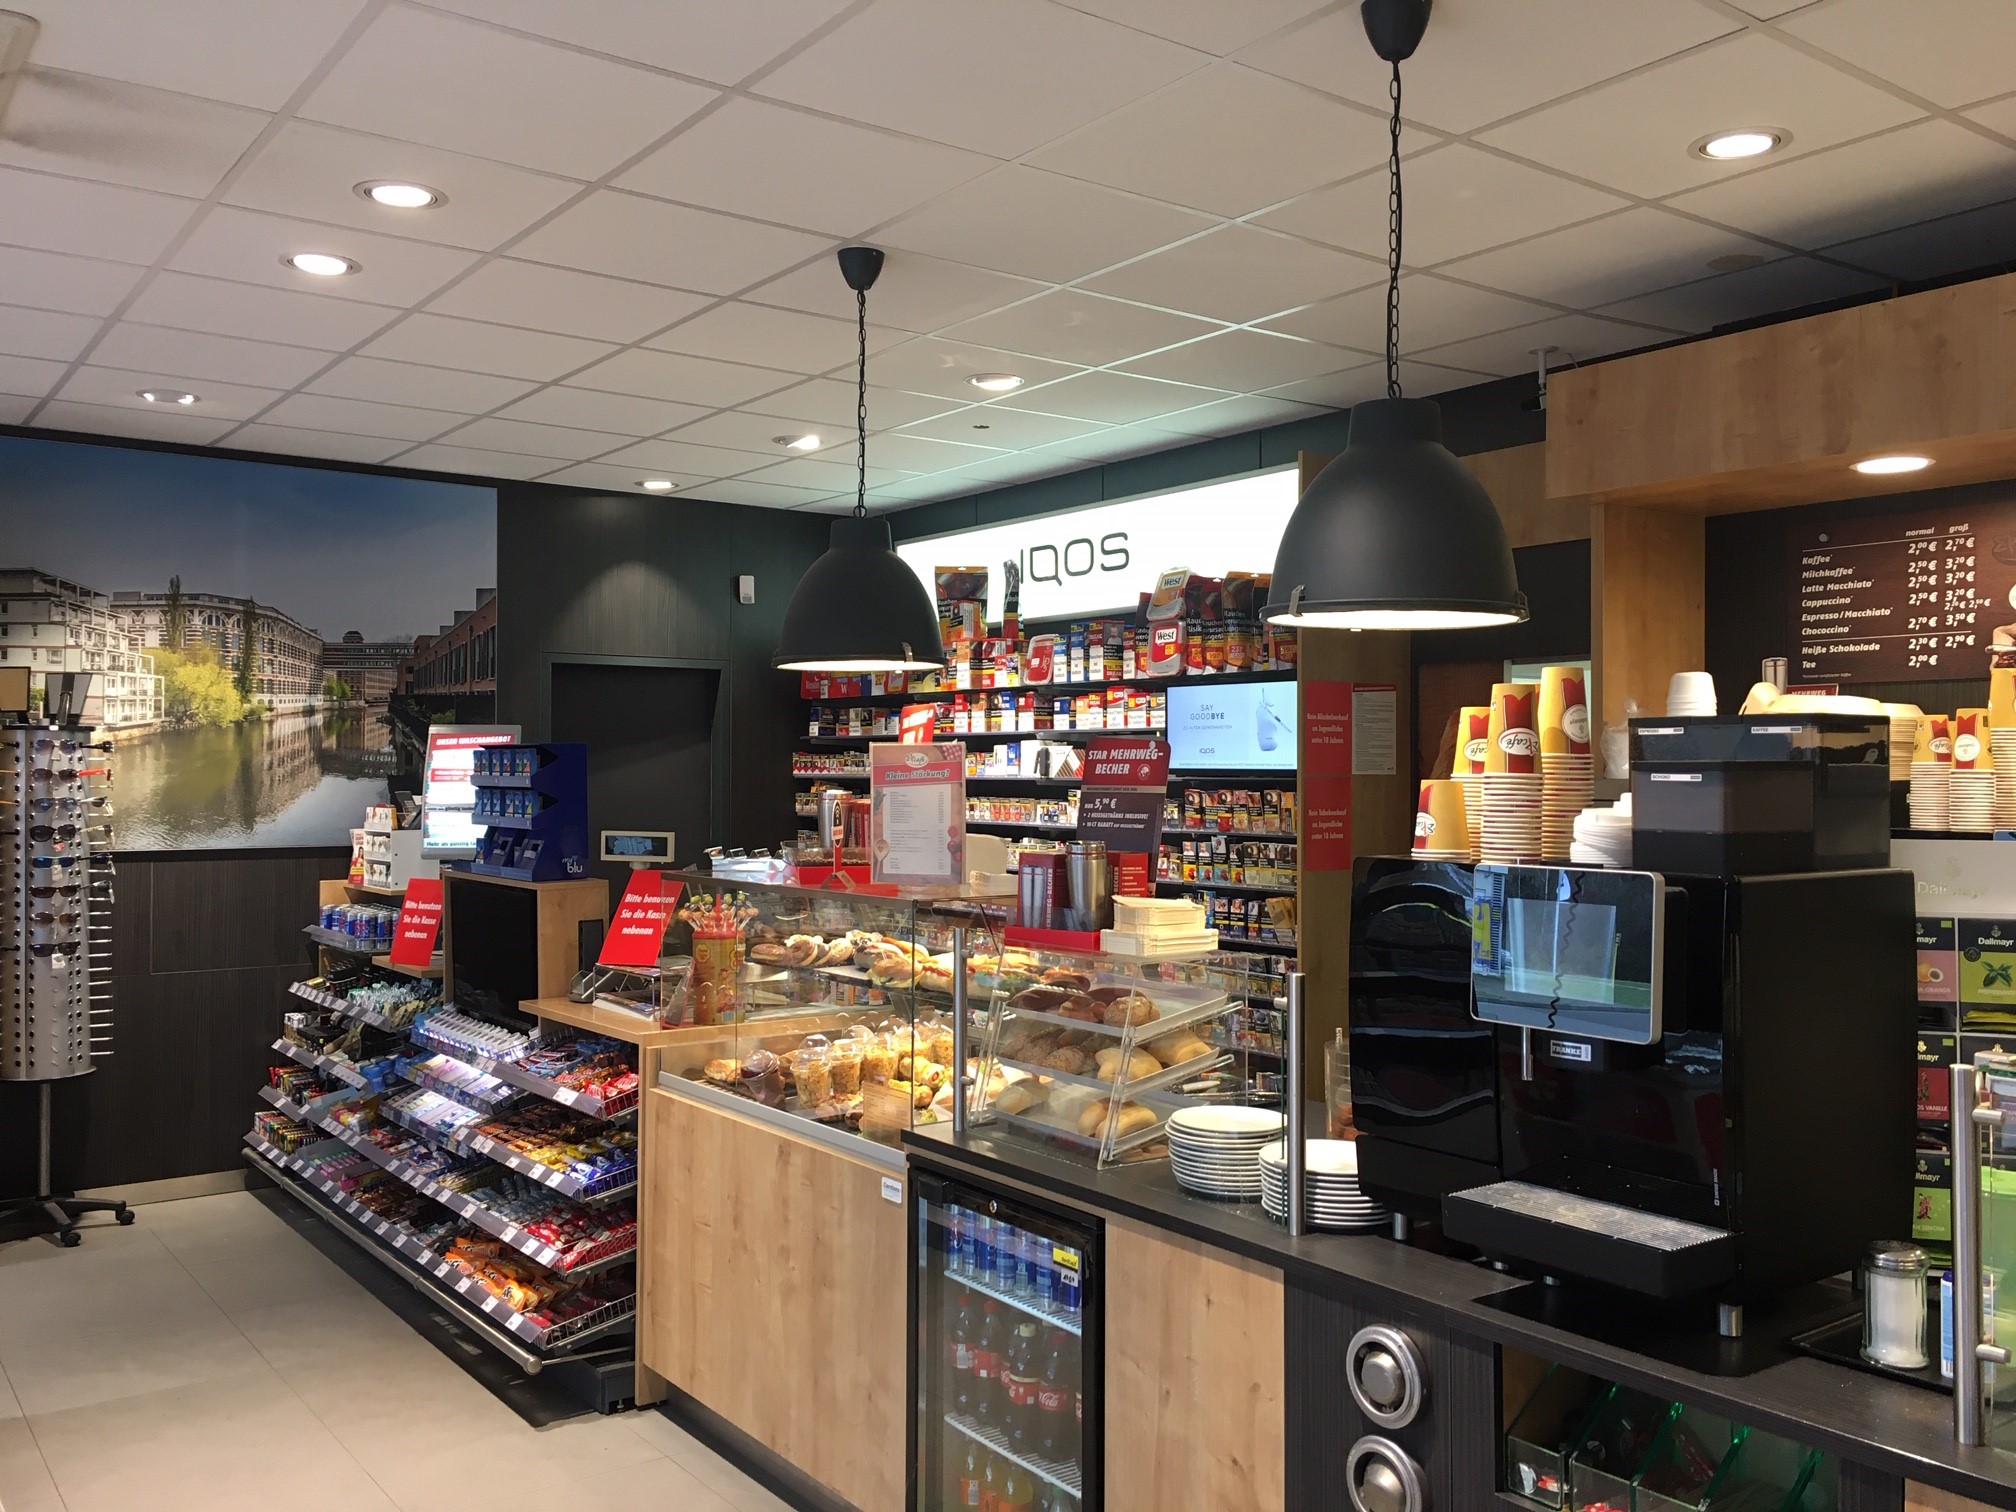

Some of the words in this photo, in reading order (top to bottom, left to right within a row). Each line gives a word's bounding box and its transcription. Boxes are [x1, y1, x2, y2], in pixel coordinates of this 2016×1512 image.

[1905, 527, 1935, 537] normal
[1949, 523, 1969, 534] groß
[1020, 532, 1130, 587] IQOS
[1164, 576, 1182, 587] West
[1802, 584, 1824, 593] Latte
[1157, 631, 1174, 641] West
[1802, 646, 1827, 655] Heiße
[1829, 643, 1880, 653] Schokolade
[1088, 750, 1108, 760] STAR
[1109, 749, 1164, 760] MEHRWEG-
[1095, 763, 1130, 774] BECHER
[885, 771, 910, 780] Kleine
[911, 769, 950, 779] Stärkung?
[566, 862, 583, 873] blu
[624, 893, 641, 903] Bitte
[643, 894, 675, 904] benutzen
[404, 900, 417, 910] Bitte
[418, 900, 442, 911] benutzen
[412, 915, 420, 924] die
[421, 916, 436, 925] Kasse
[620, 910, 633, 918] Sie
[635, 910, 644, 918] die
[646, 910, 665, 919] Kasse
[404, 929, 427, 939] nebenan
[621, 925, 653, 935] nebenan
[1978, 938, 2014, 947] Dallmayr
